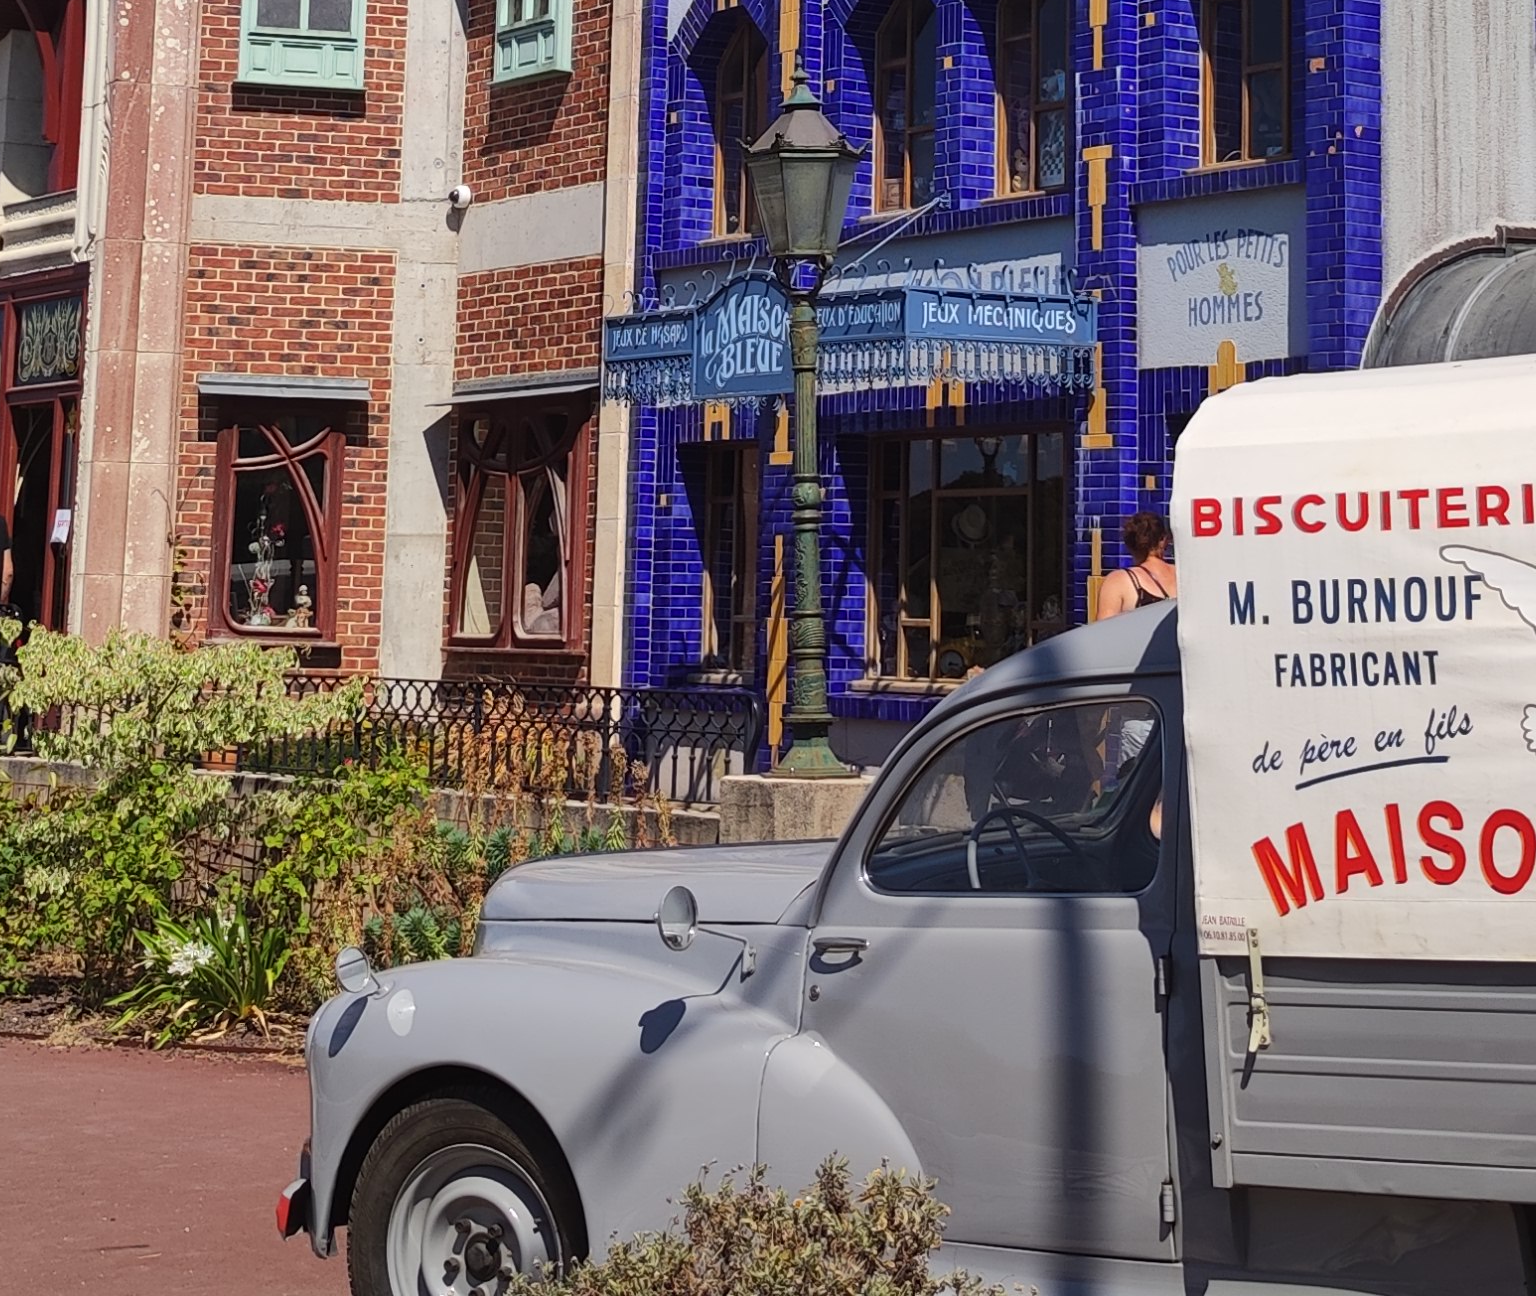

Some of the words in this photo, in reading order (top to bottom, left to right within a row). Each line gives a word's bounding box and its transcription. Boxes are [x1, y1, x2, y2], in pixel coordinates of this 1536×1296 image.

[1167, 240, 1205, 282] POUR
[1206, 229, 1230, 261] LES
[1237, 228, 1287, 268] PETITS
[816, 308, 836, 328] EUX
[922, 301, 960, 329] JEUX
[1189, 291, 1264, 327] HOMMES
[613, 328, 634, 351] JEUX
[635, 327, 647, 346] DE
[717, 337, 784, 388] BLEUE
[1229, 580, 1270, 626] M.
[1291, 574, 1483, 625] BURNOUF
[1274, 650, 1439, 688] FABRICANT
[1251, 742, 1284, 774] de
[1297, 731, 1358, 778] père
[1374, 728, 1406, 753] en
[1424, 705, 1475, 760] fils
